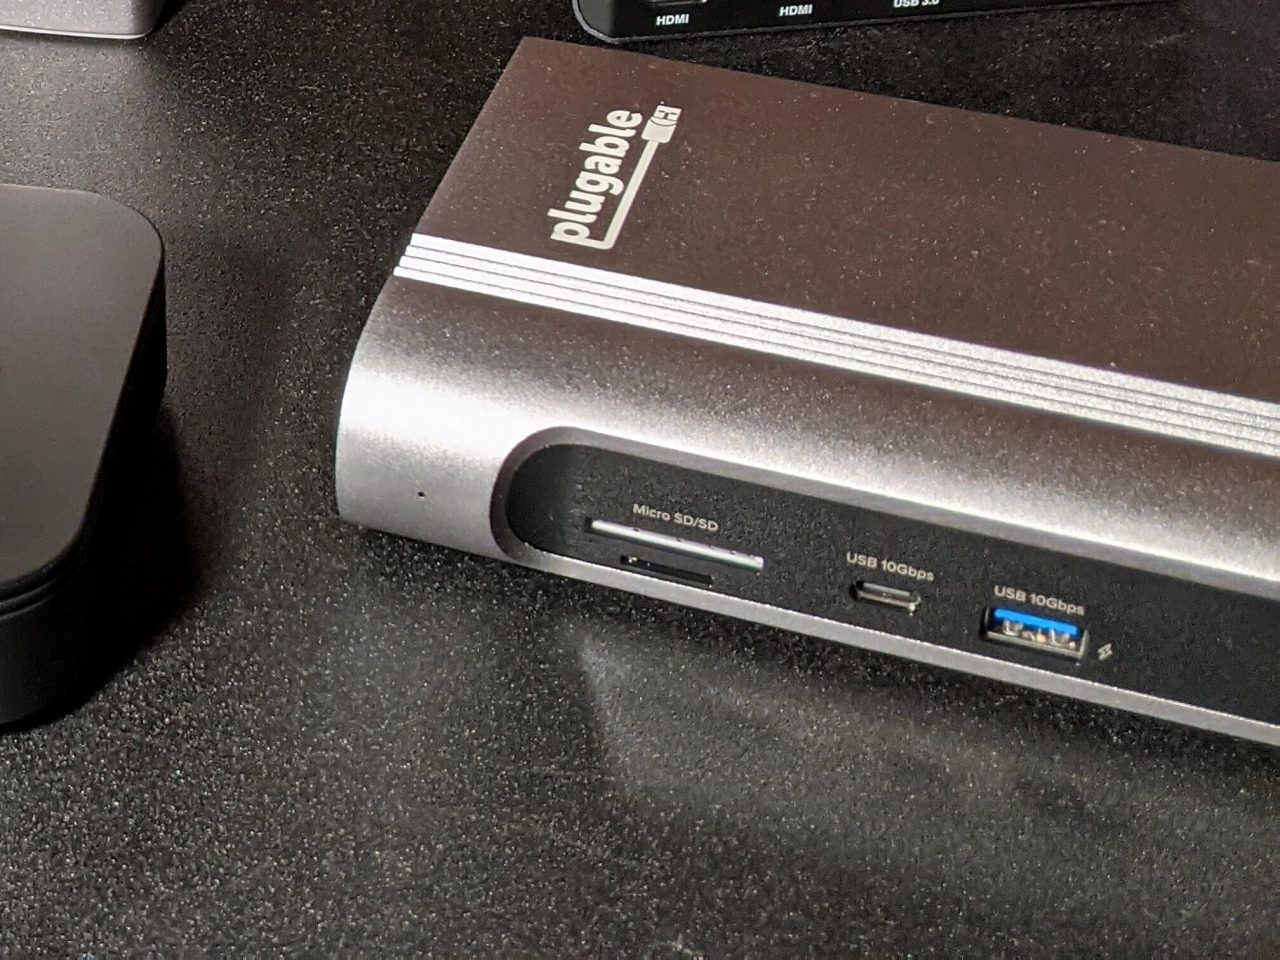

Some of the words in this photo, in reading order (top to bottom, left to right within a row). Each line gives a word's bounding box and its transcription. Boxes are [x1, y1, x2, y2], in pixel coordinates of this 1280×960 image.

[656, 13, 690, 27] HDMI
[779, 3, 813, 18] HDMI
[547, 109, 643, 250] plugable
[632, 503, 671, 522] Micro
[673, 512, 719, 532] SD/SD
[846, 551, 878, 569] USB
[881, 558, 935, 582] 10Gbps
[994, 584, 1026, 603] USB
[1029, 592, 1085, 617] 10Gbps
